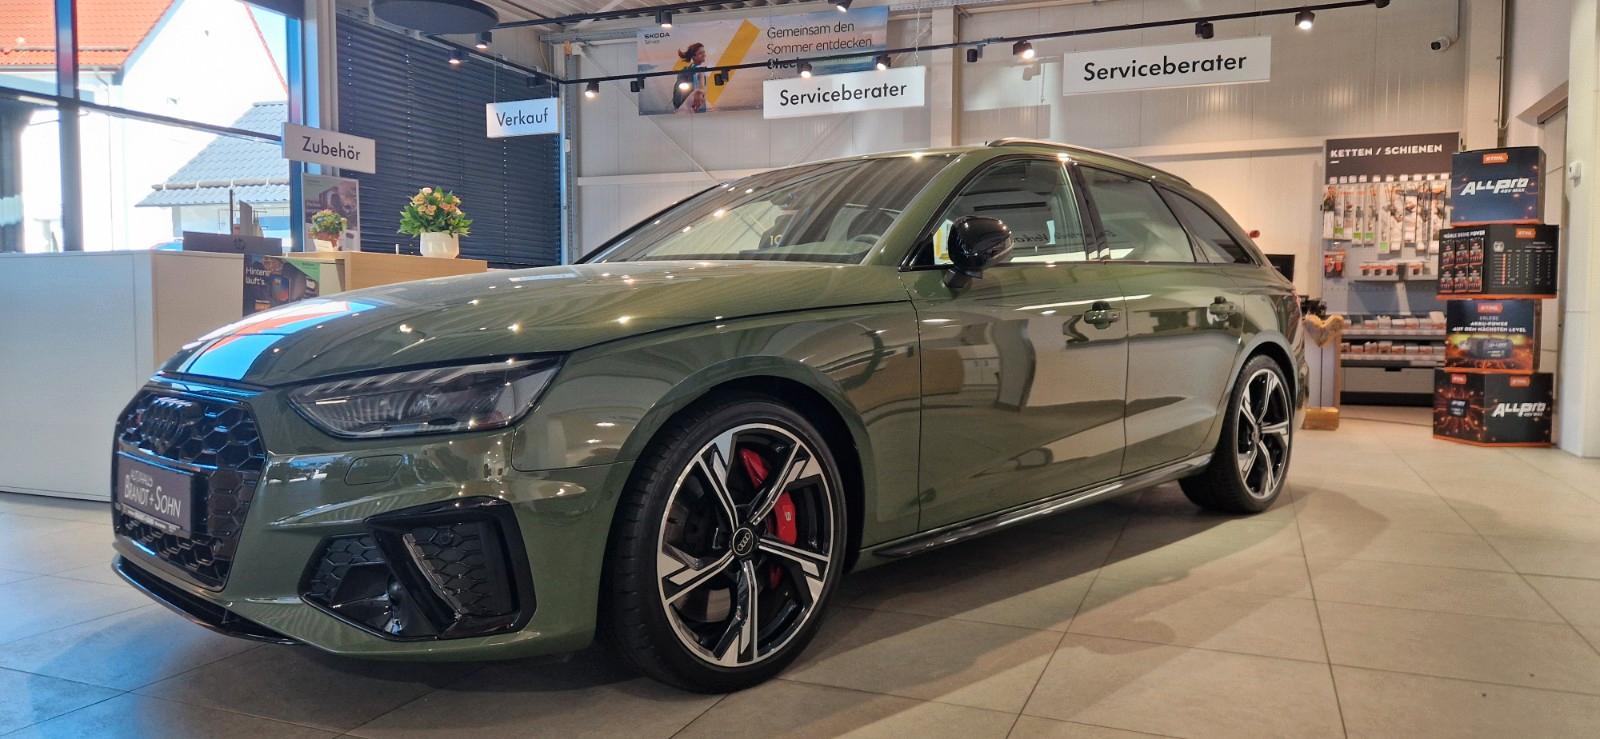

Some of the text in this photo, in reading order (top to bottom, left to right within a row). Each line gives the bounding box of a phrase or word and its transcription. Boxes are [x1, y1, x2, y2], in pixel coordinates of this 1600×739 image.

[767, 21, 855, 39] Gemeinsam den
[767, 43, 813, 55] Sommer
[1083, 54, 1247, 82] Serviceberater
[779, 83, 907, 106] Serviceberater
[496, 107, 549, 127] Verkauf
[302, 135, 361, 161] Zubehör
[1330, 148, 1373, 158] KETTEN
[1384, 144, 1443, 155] SCHIENEN
